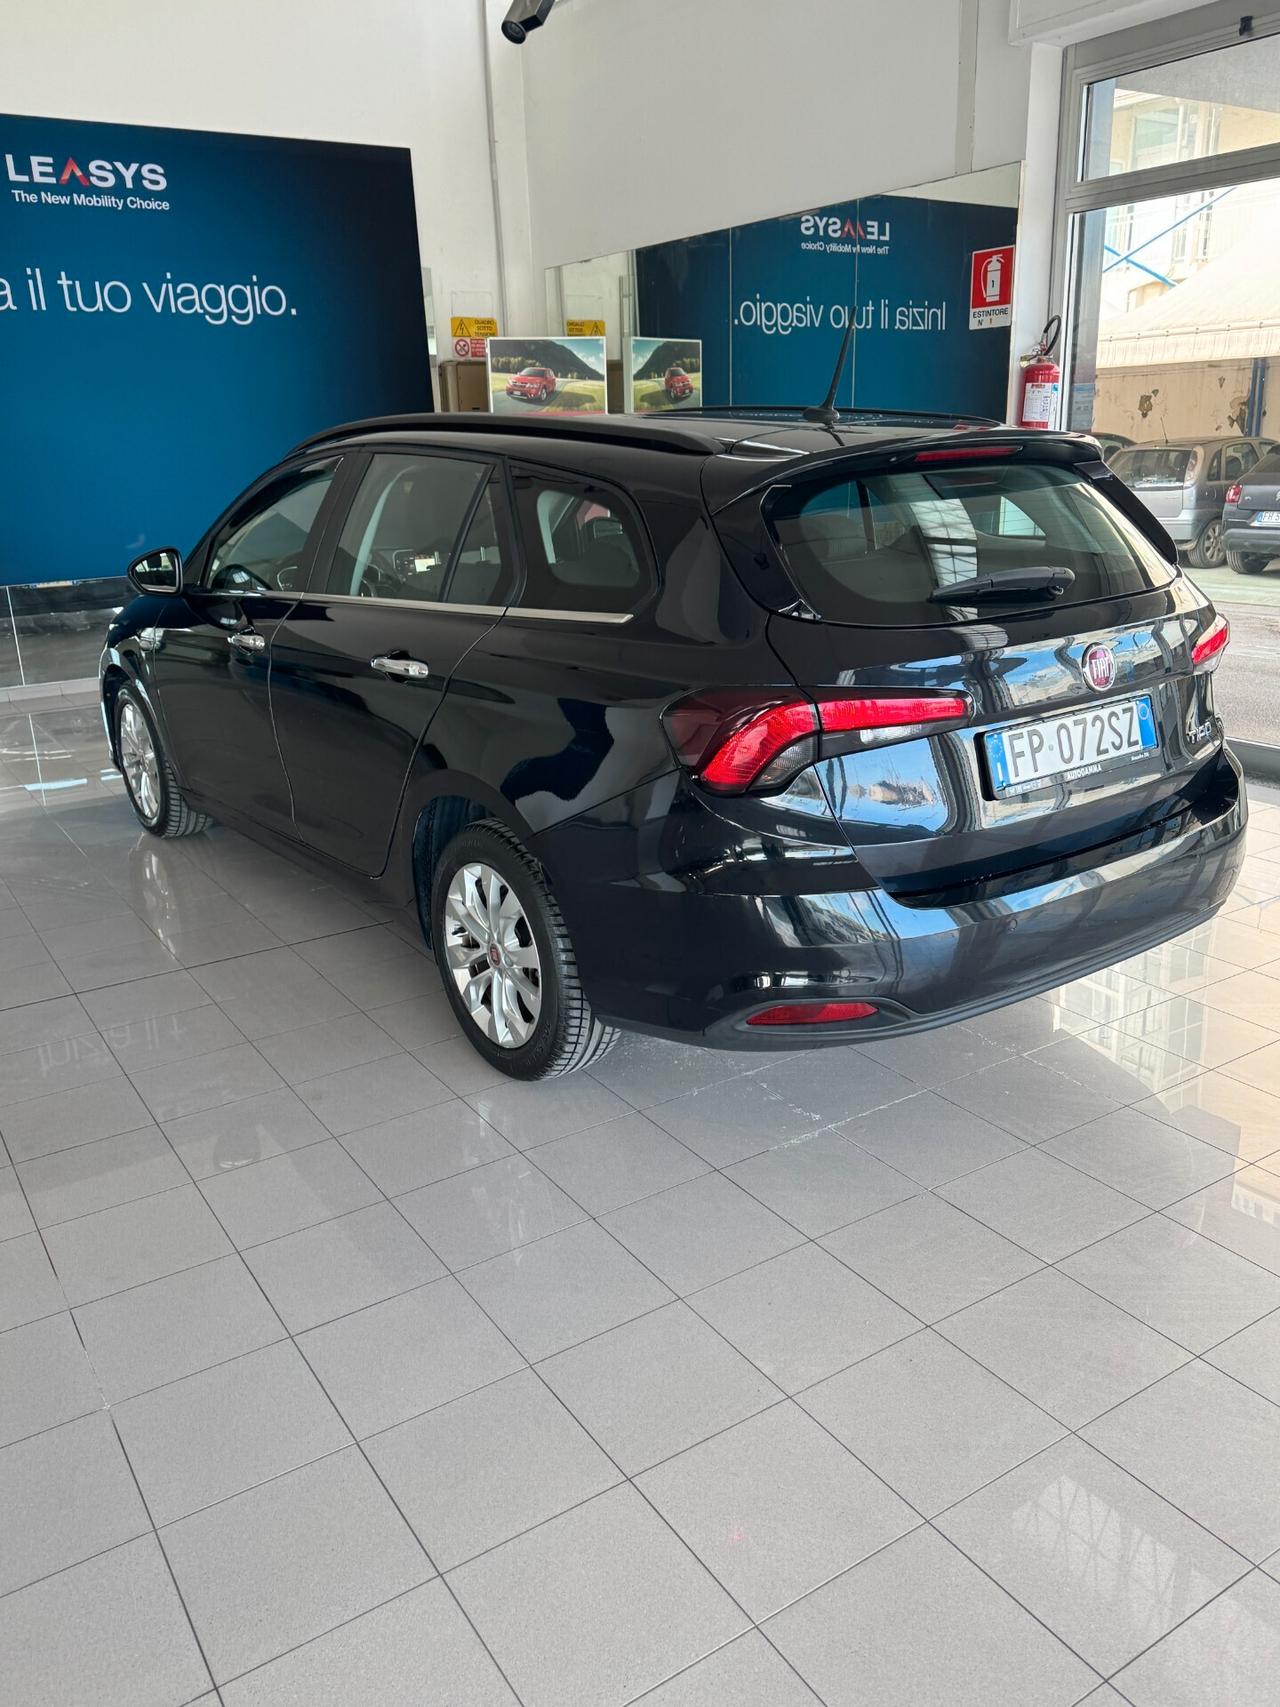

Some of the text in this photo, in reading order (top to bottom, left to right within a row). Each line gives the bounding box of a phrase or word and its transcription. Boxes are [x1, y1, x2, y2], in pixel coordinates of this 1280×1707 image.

[5, 154, 167, 191] LEASYS
[11, 189, 170, 211] The New Mobility Choice
[26, 267, 47, 311] il
[57, 271, 132, 312] tuo
[142, 272, 298, 325] viaggio.
[972, 307, 1009, 319] ESTINTORE
[1091, 657, 1111, 680] FIAT
